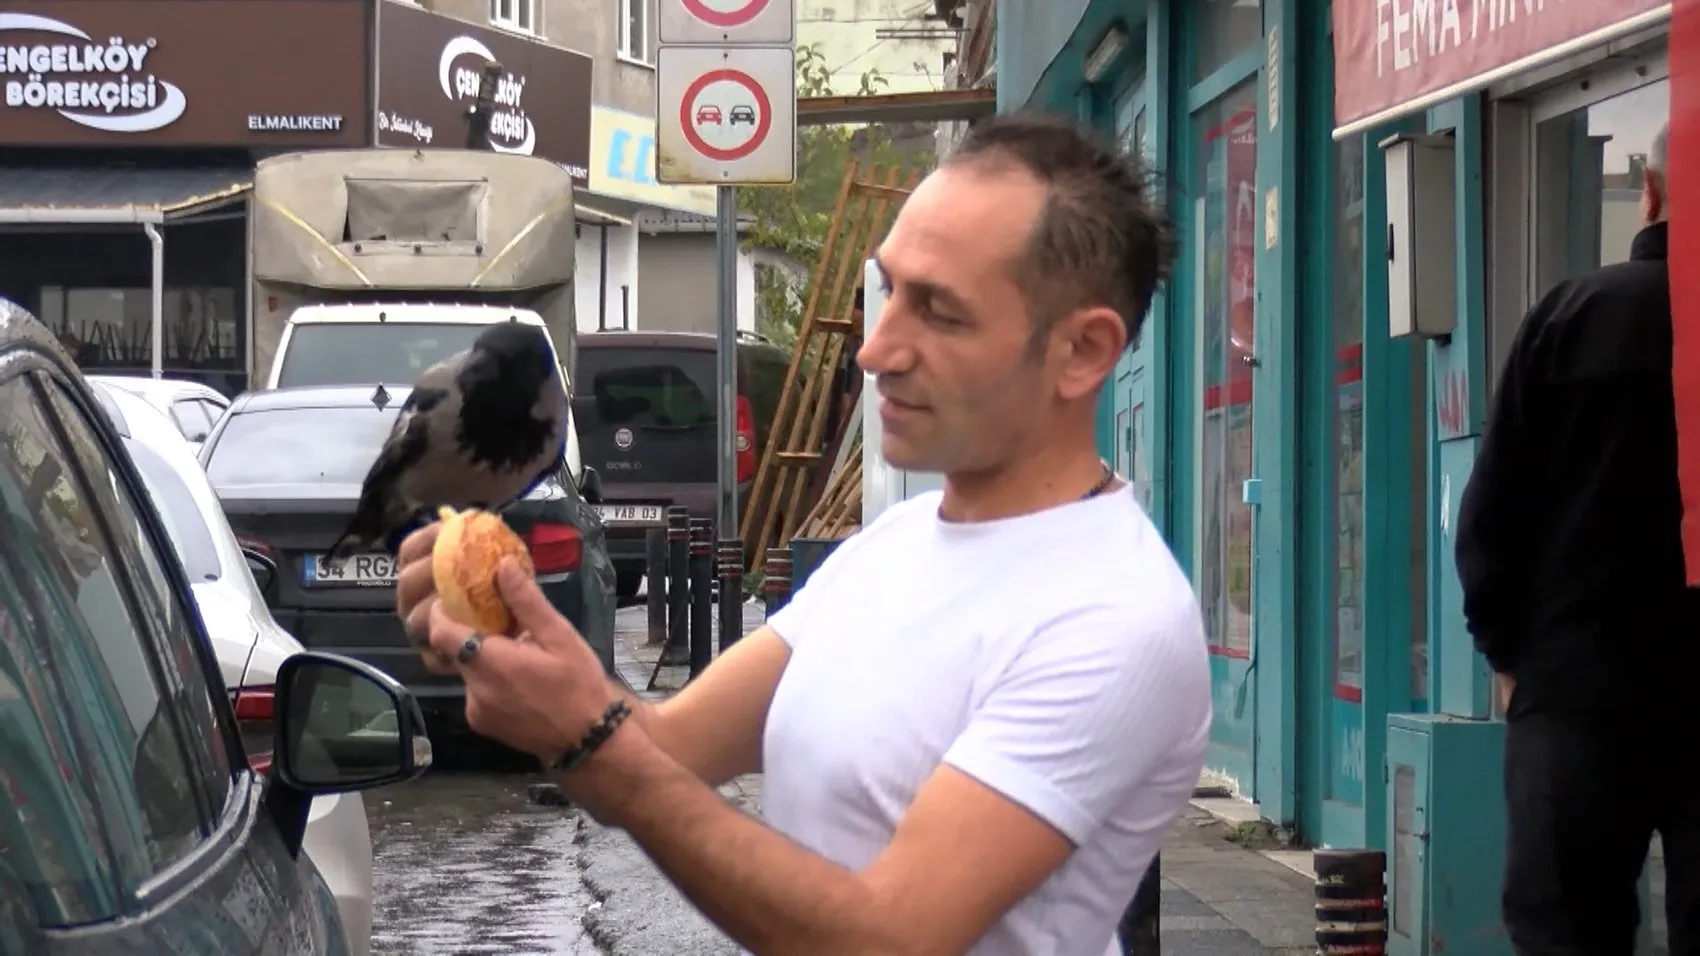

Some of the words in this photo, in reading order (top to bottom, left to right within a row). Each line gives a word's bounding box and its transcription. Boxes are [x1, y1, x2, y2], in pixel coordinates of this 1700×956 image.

[1376, 0, 1462, 78] FEMA
[6, 73, 157, 113] BÖREKÇİSİ
[248, 115, 344, 131] ELMALIKENT
[491, 107, 525, 142] EKÇİSİ
[614, 506, 635, 519] VAB
[642, 508, 657, 519] 03
